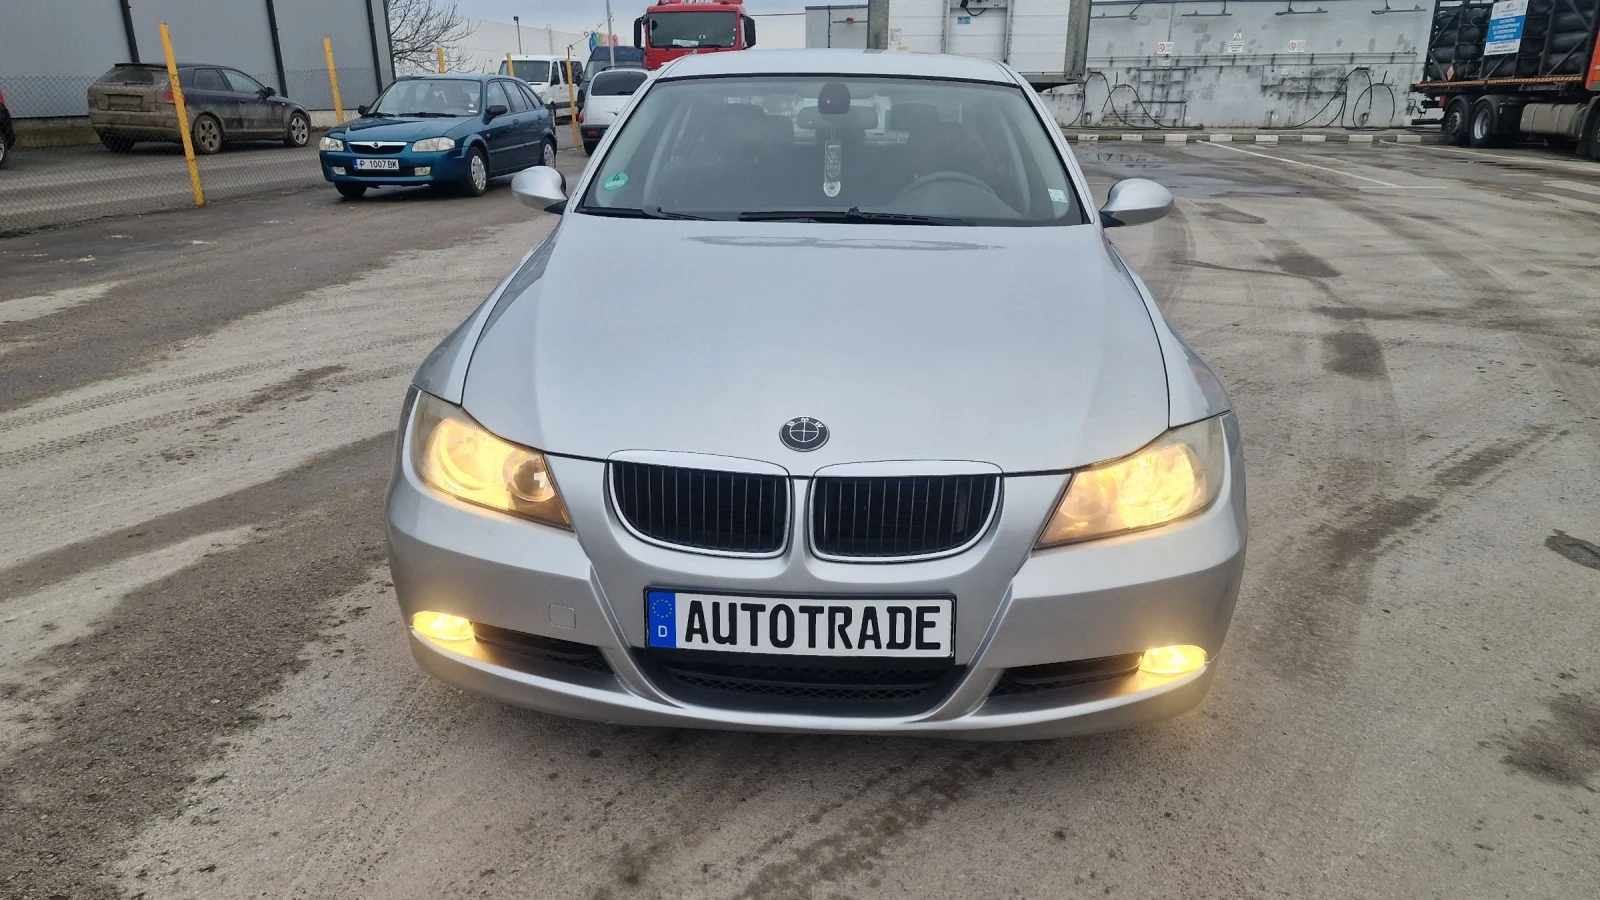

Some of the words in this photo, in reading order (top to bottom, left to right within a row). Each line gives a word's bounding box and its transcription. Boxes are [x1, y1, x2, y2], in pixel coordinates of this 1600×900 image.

[370, 160, 386, 168] 1007
[612, 172, 620, 181] 4
[658, 625, 668, 638] D
[685, 600, 941, 650] AUTOTRADE
